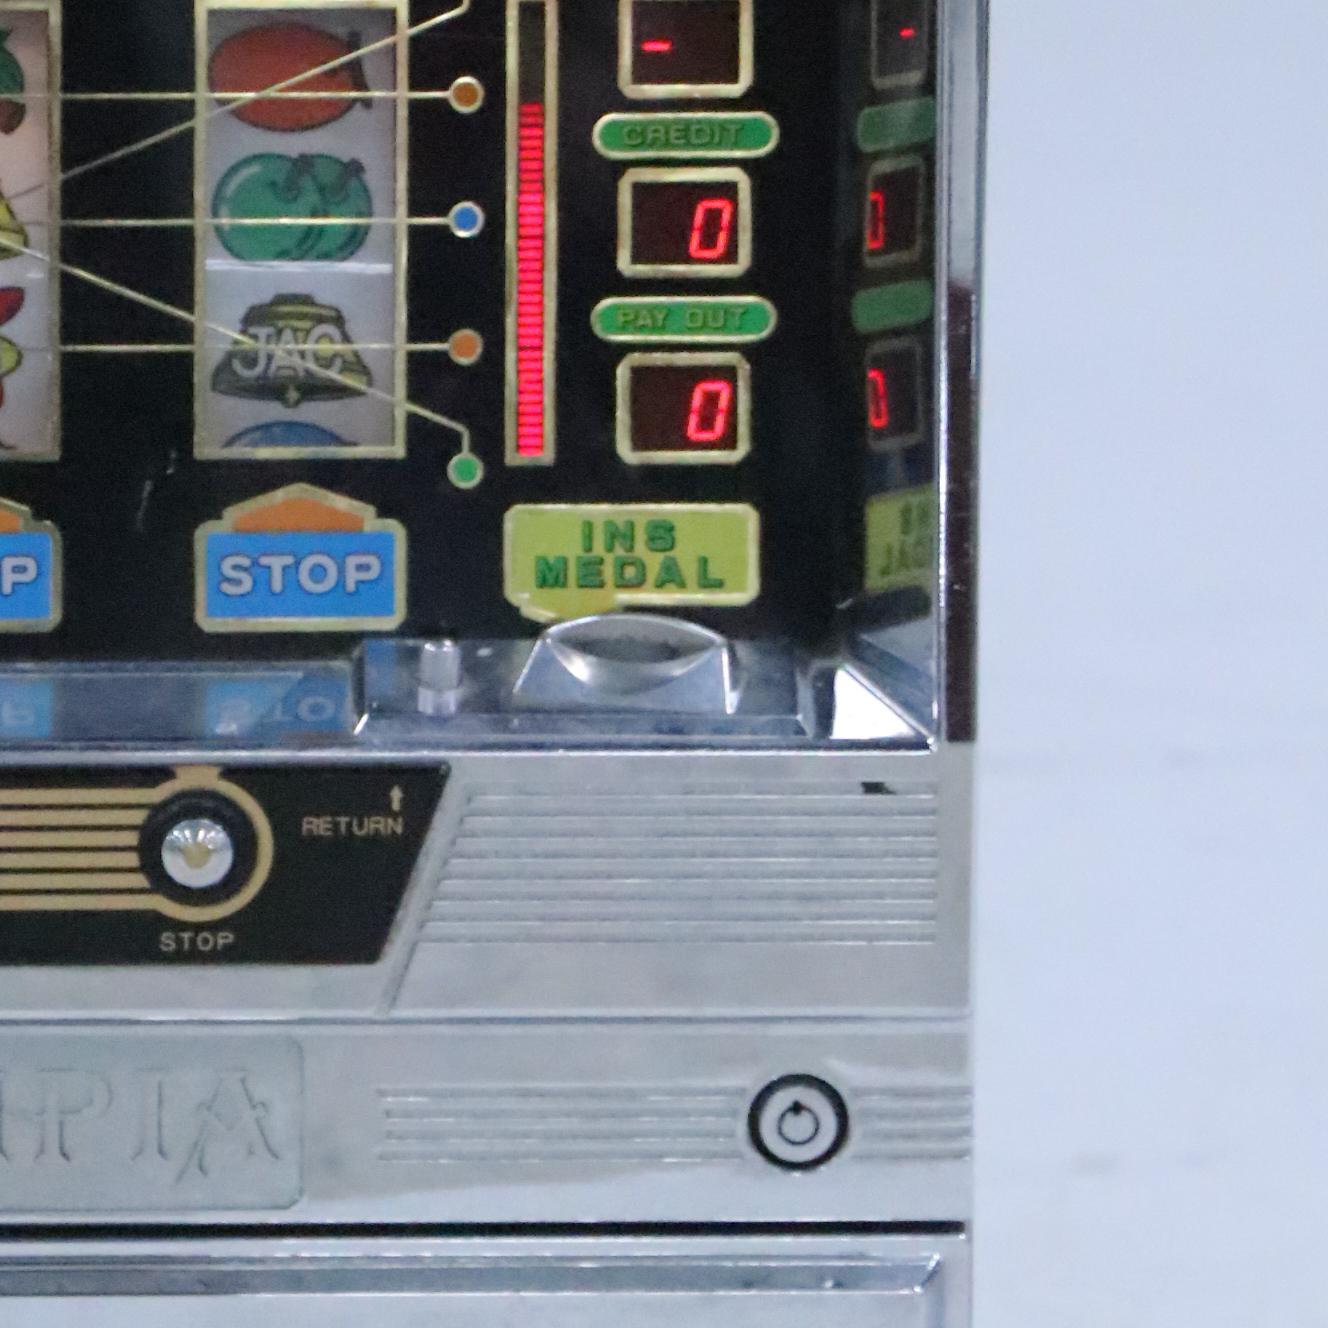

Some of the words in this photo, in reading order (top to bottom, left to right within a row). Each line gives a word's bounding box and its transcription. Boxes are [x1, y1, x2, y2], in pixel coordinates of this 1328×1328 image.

[622, 123, 746, 146] CREDIT
[688, 197, 734, 260] 0
[616, 306, 667, 331] PAY
[684, 305, 748, 330] OUT
[230, 324, 344, 378] JAC
[686, 378, 733, 442] 0
[580, 519, 677, 553] INS
[218, 553, 383, 596] STOP
[534, 555, 726, 589] MEDAL
[301, 816, 404, 837] RETURN
[159, 932, 235, 953] STOP
